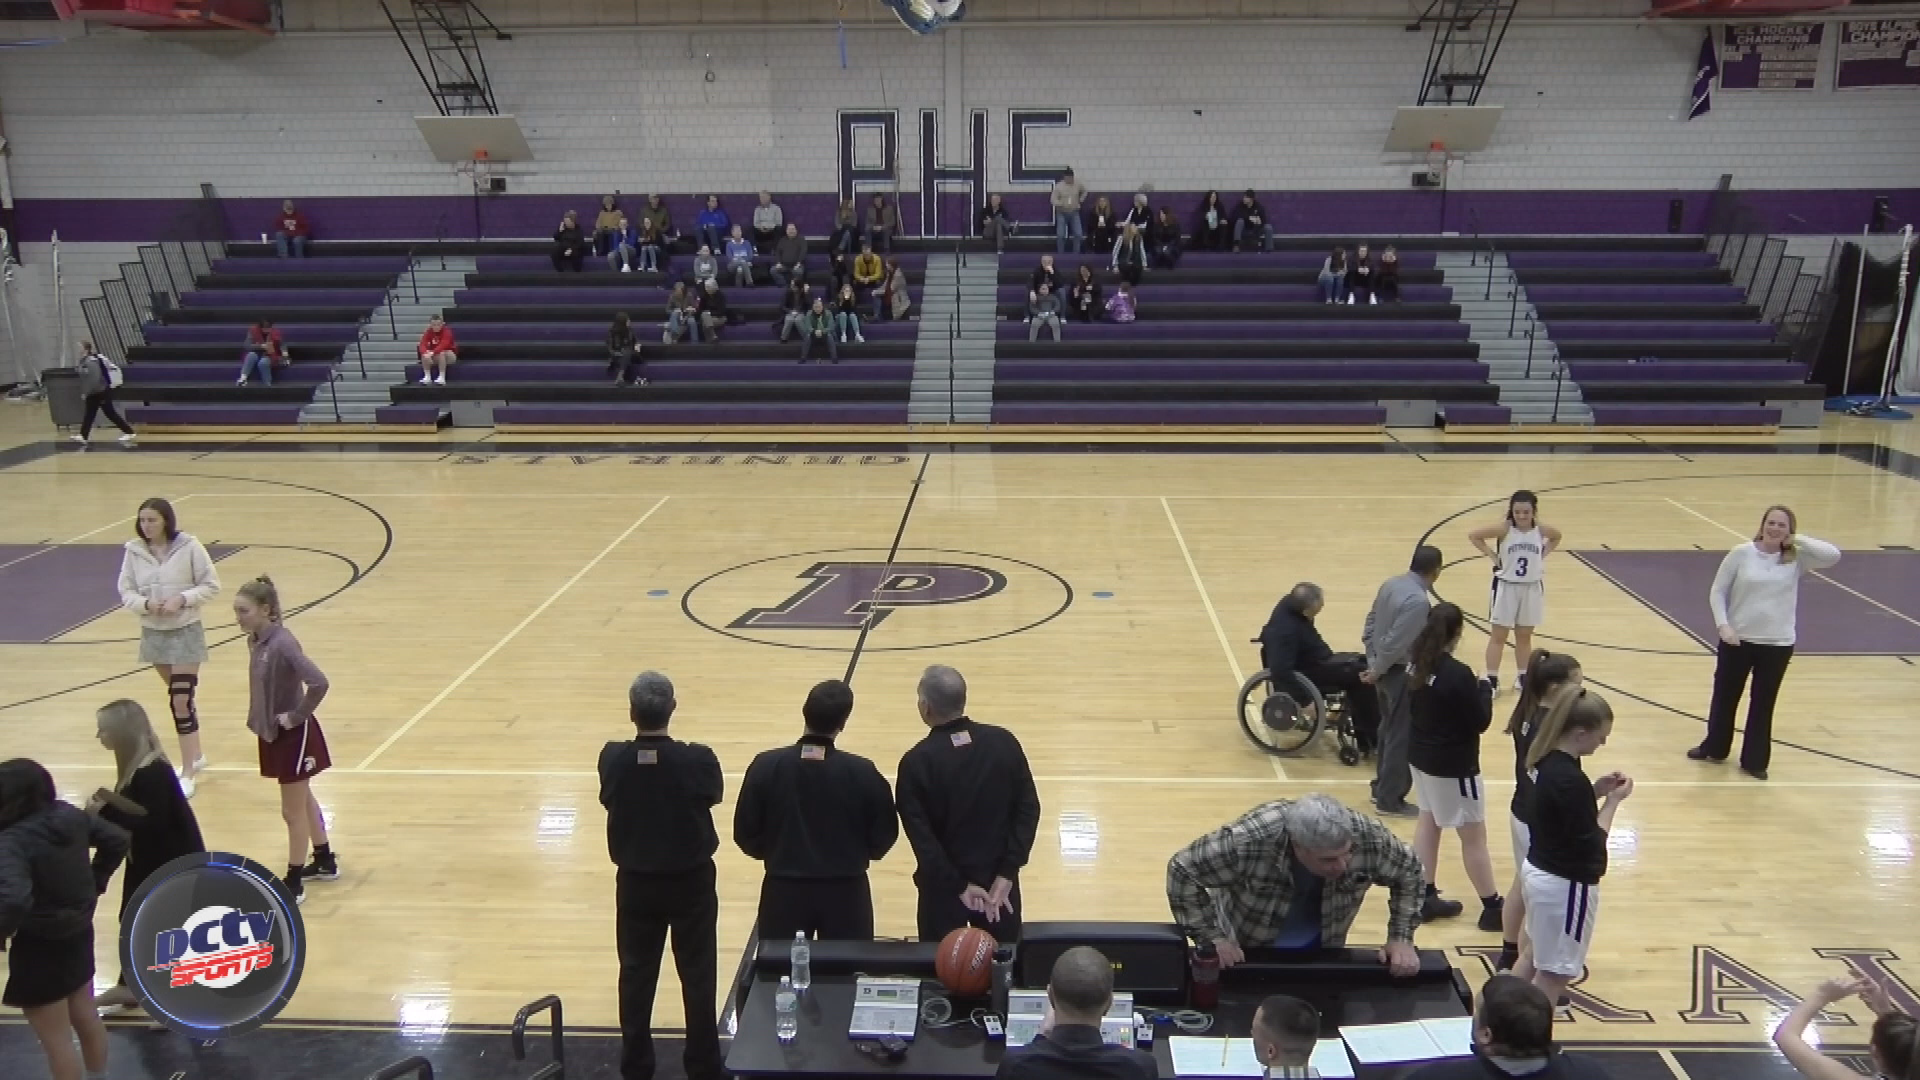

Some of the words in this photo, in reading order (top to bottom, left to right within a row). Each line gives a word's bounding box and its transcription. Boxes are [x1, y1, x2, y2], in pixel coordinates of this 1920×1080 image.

[1733, 26, 1756, 35] ICE
[1759, 25, 1815, 35] HOCKEY
[1736, 35, 1810, 45] CHAMPIONS
[836, 108, 1071, 238] PHS
[1507, 543, 1540, 555] PITTSFIELD
[1514, 555, 1529, 577] 3
[724, 561, 1008, 631] P
